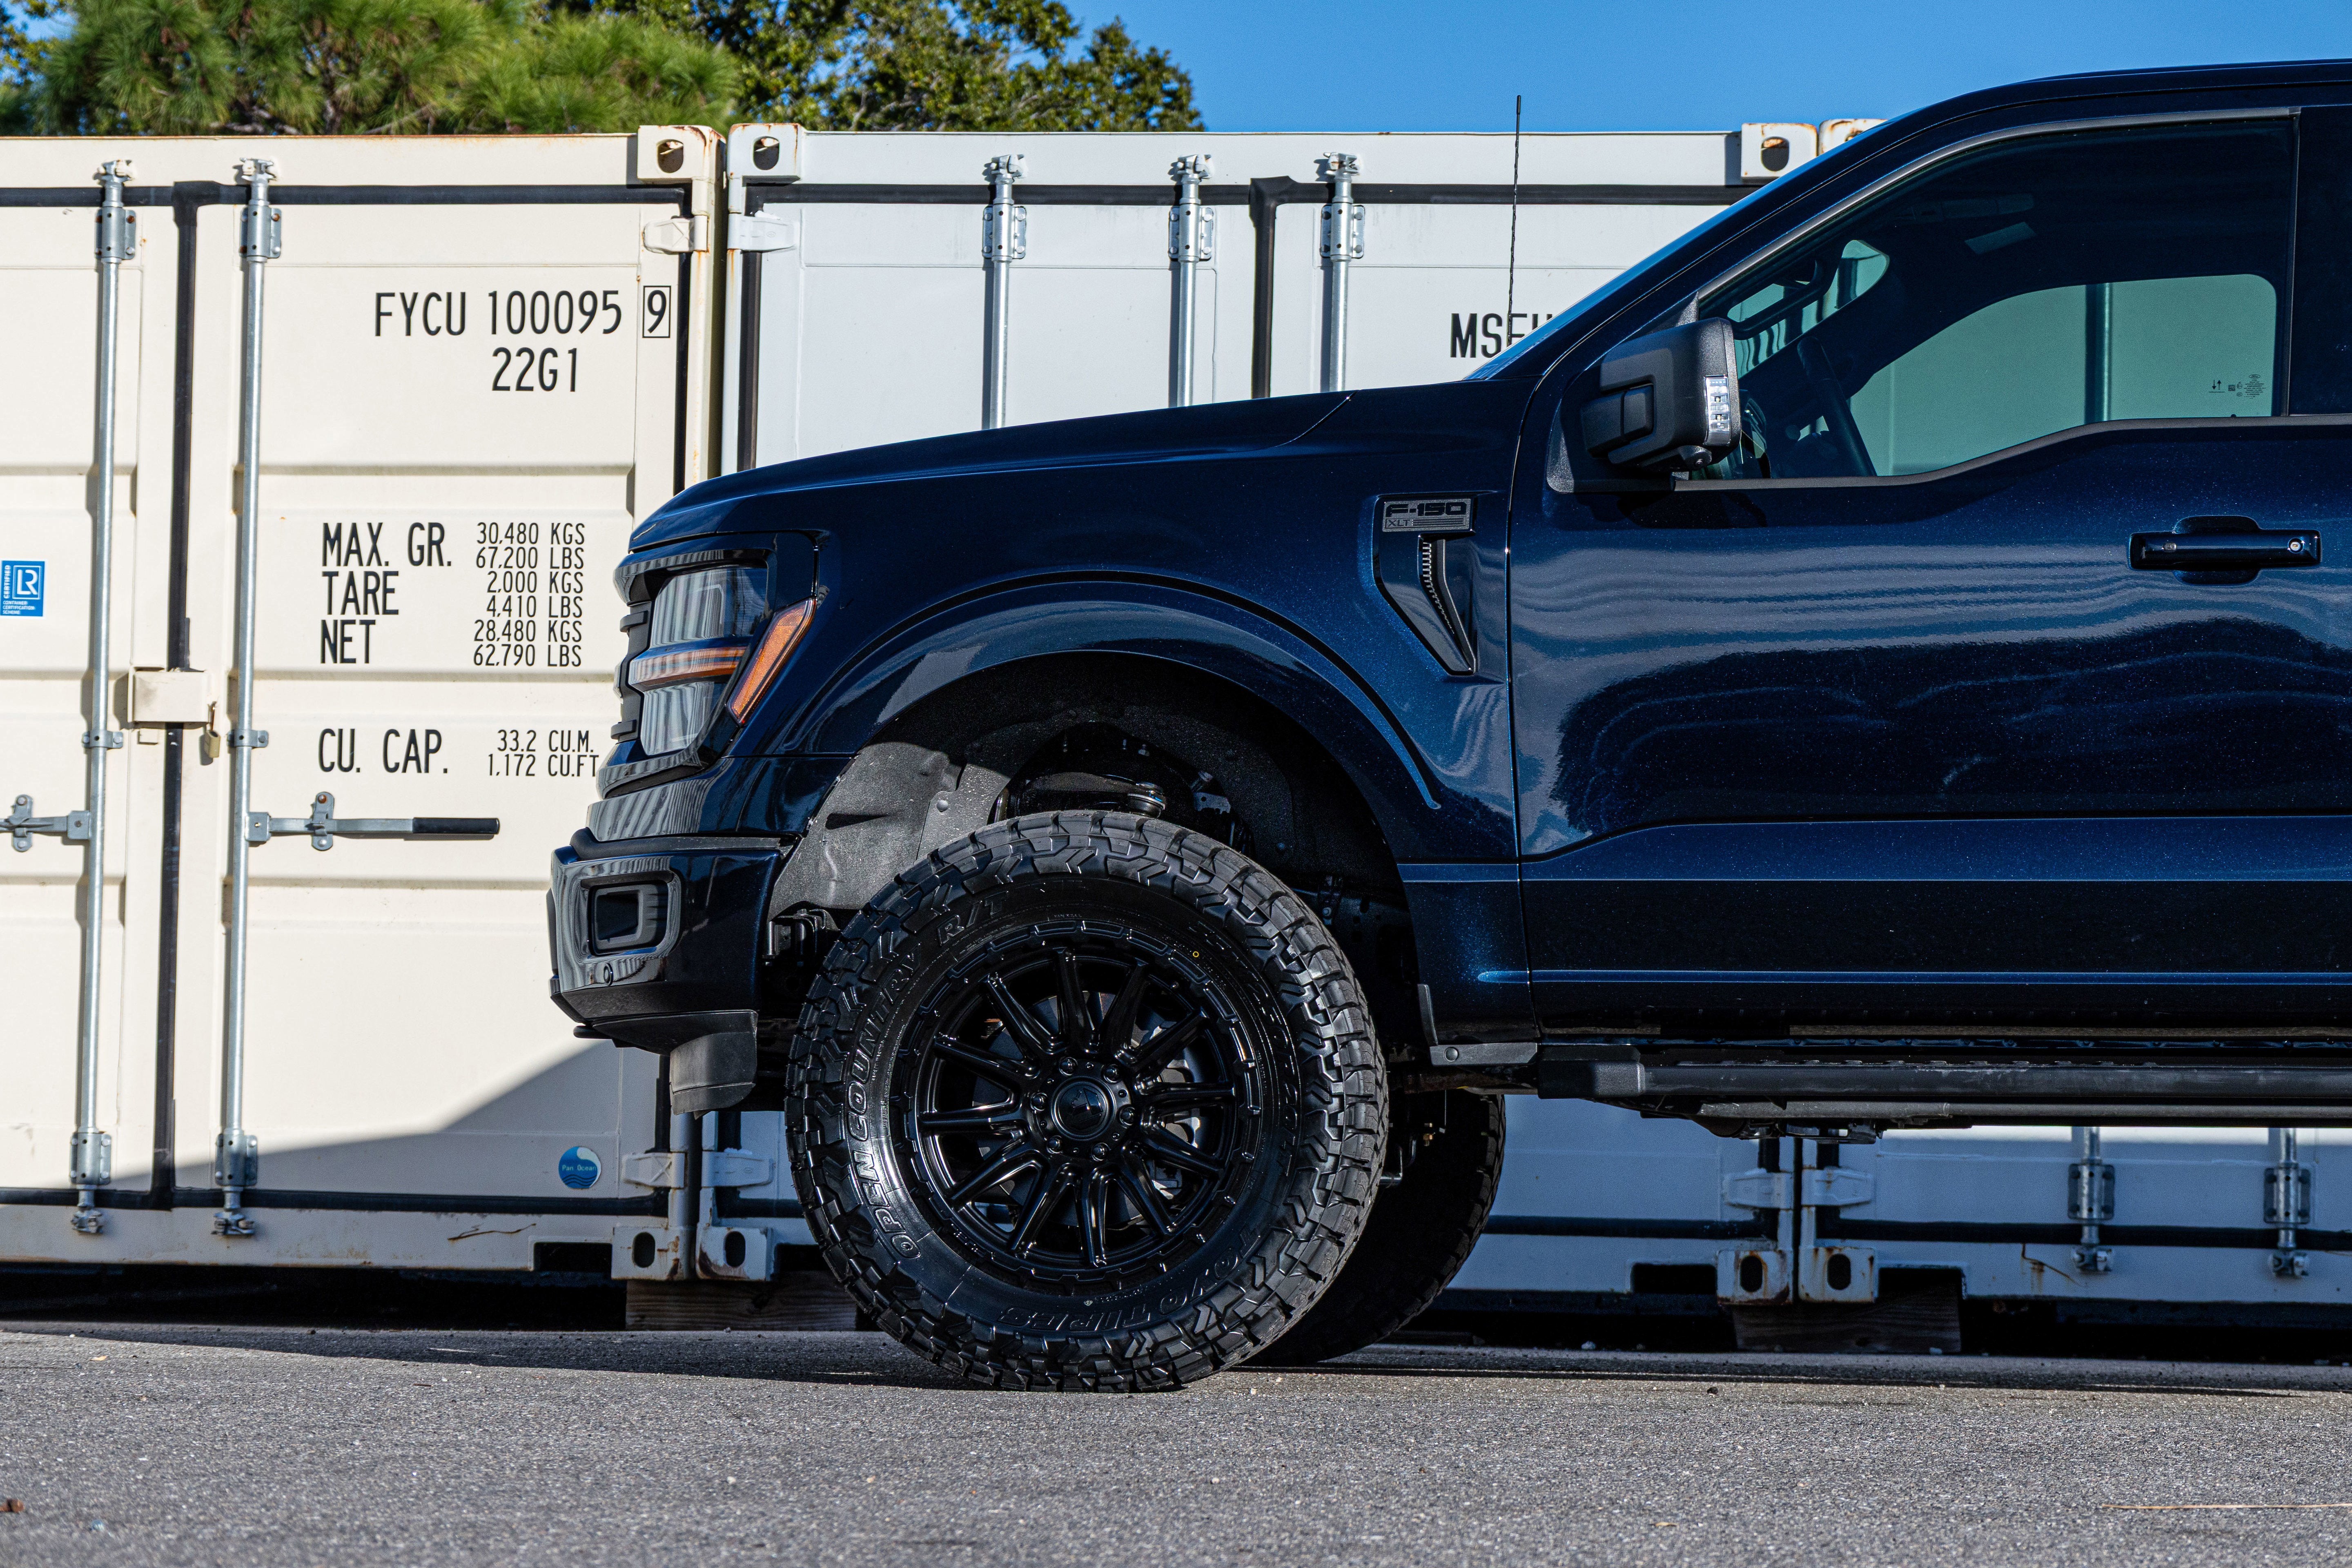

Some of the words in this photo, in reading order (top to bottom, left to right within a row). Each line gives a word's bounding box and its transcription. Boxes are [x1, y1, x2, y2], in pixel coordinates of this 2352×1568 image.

[375, 292, 466, 336] FYCU
[488, 290, 621, 335] 100095
[647, 290, 667, 334] 9
[492, 347, 577, 392] 22G1
[1385, 501, 1467, 517] F-150
[322, 522, 389, 567] MAX.
[408, 522, 451, 566] GR.
[551, 523, 585, 545] KGS
[550, 547, 584, 569] LBS
[17, 569, 38, 595] LR
[322, 571, 399, 615] TARE
[549, 571, 584, 594] KGS
[548, 596, 583, 618] LBS
[321, 619, 376, 664] NET
[548, 620, 582, 642] KGS
[548, 644, 581, 667] LBS
[318, 728, 360, 773] CU.
[383, 729, 448, 773] CAP.
[497, 729, 537, 752] 33.2
[549, 730, 593, 753] CU.M.
[937, 891, 1009, 946] R/T
[846, 943, 922, 1141] COUNTRY
[852, 1150, 921, 1259] OPEN
[1159, 1227, 1261, 1315] TOYO
[998, 1305, 1151, 1331] TIRES
